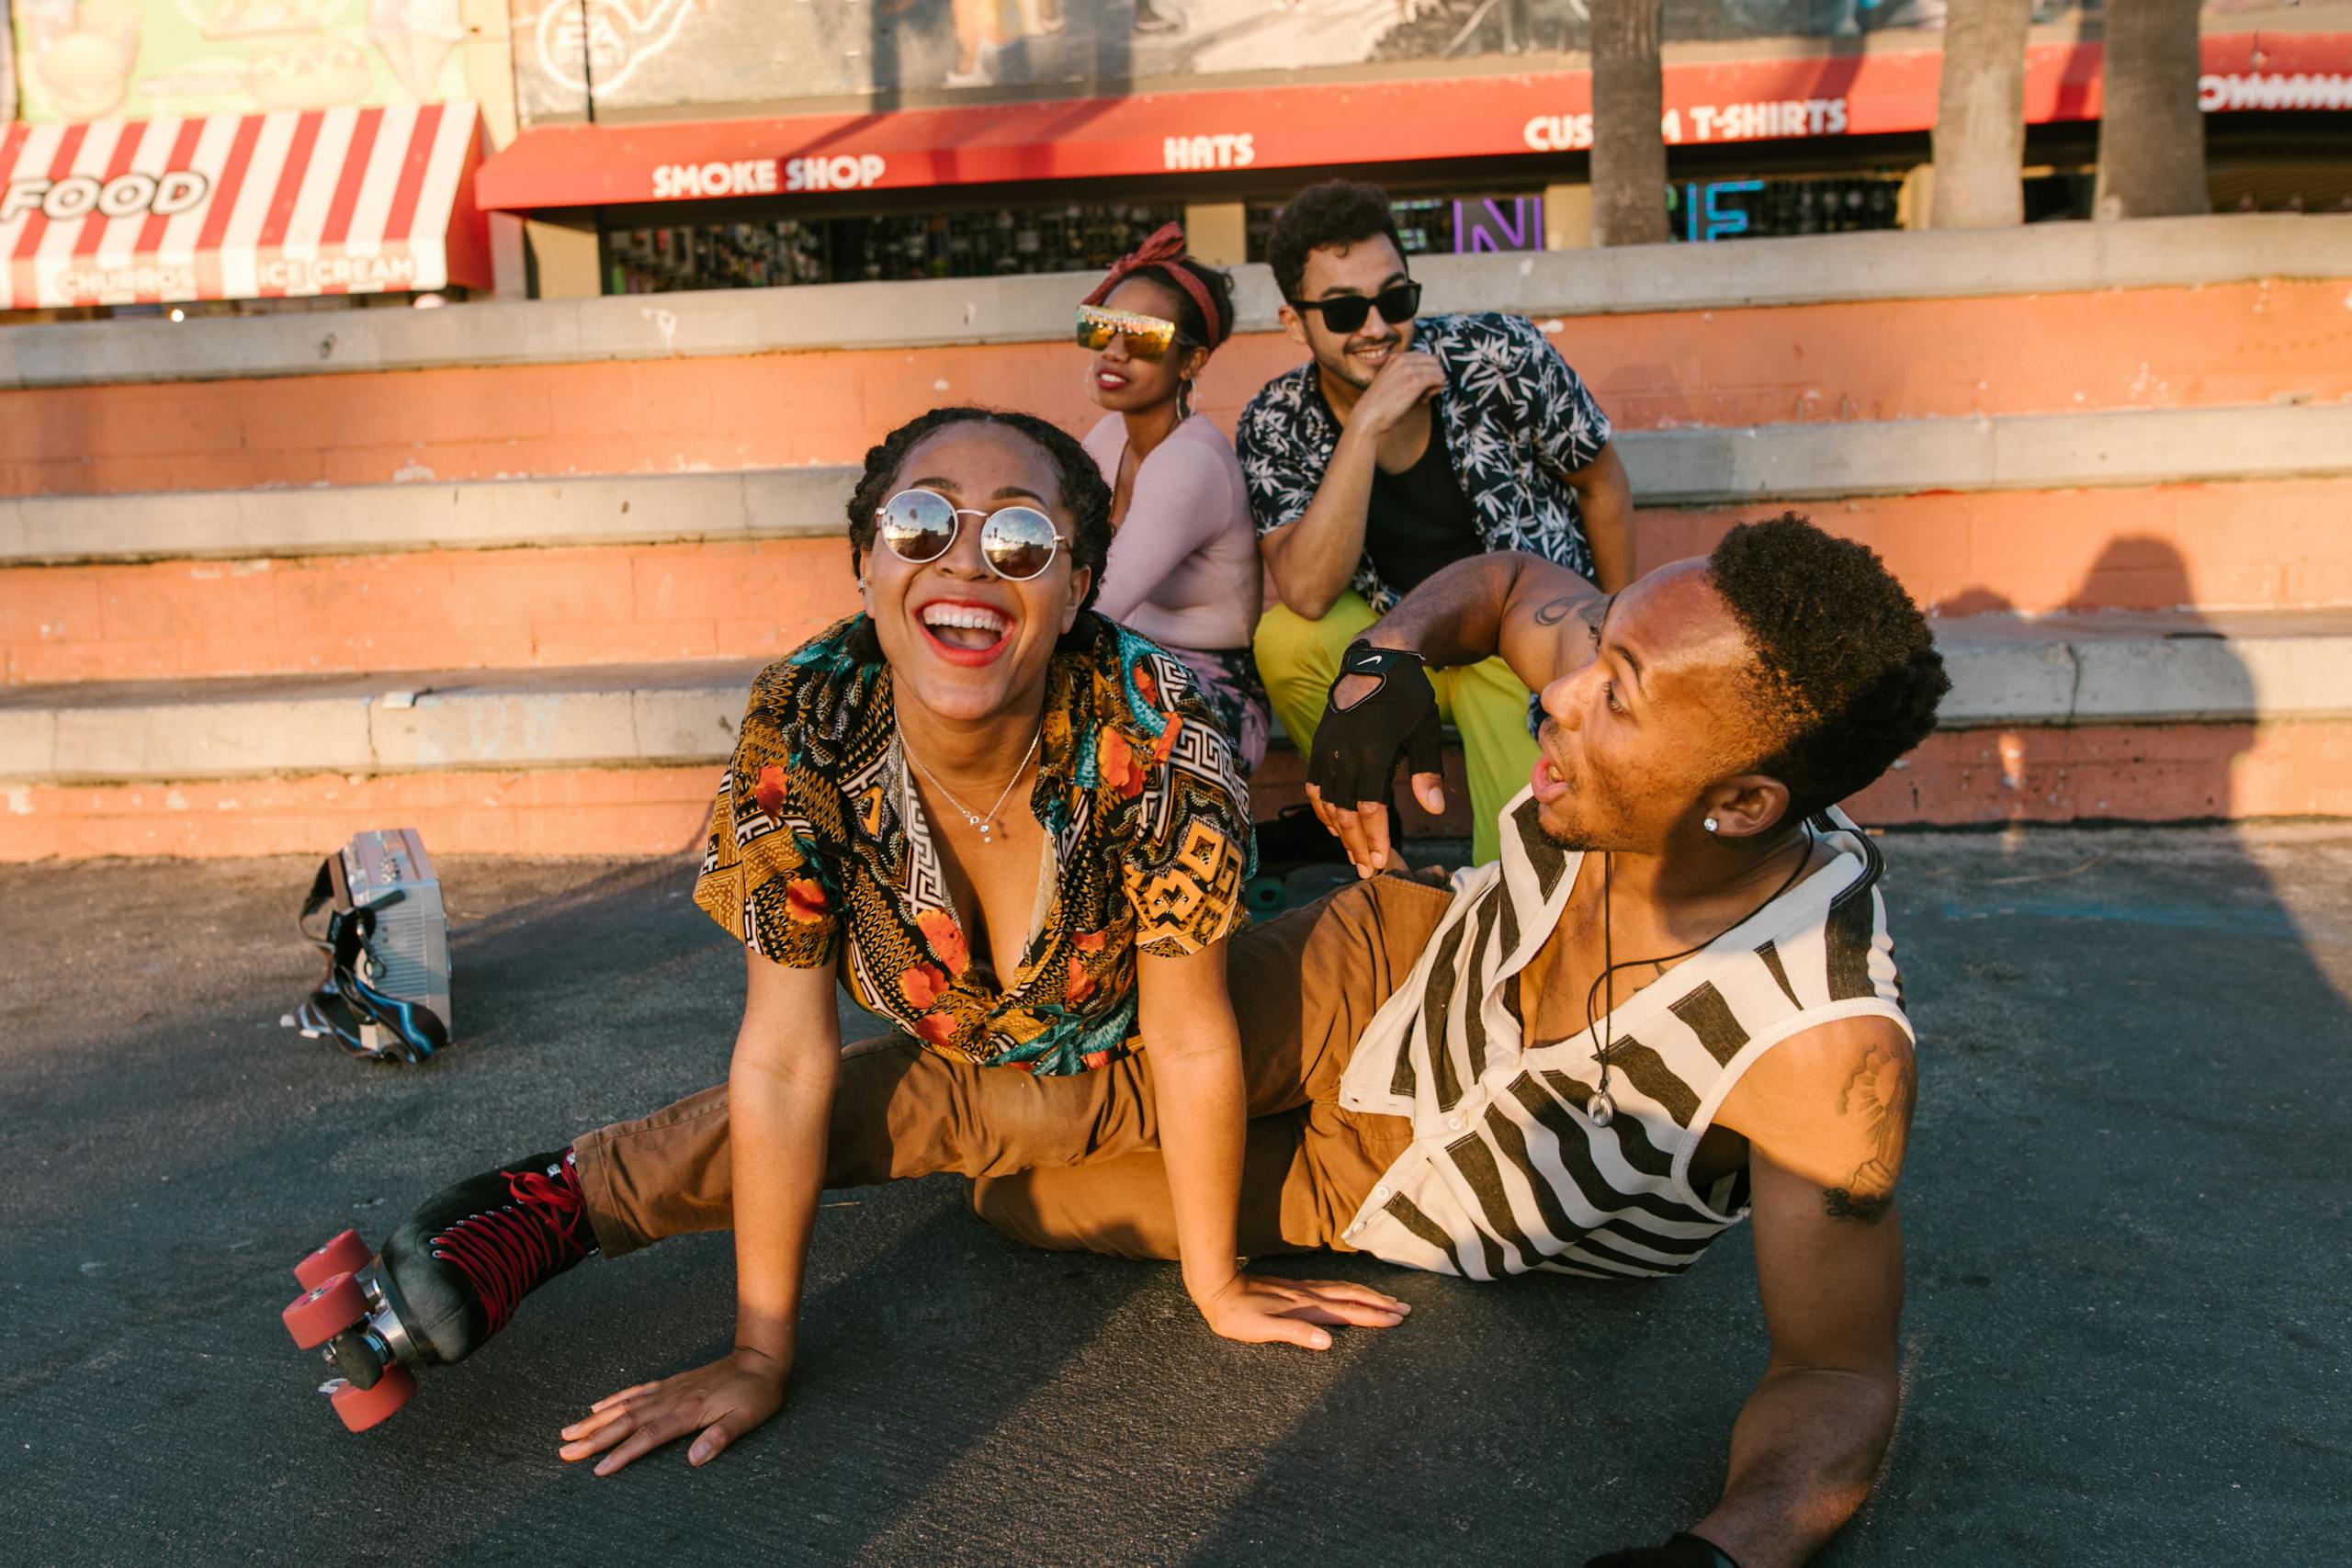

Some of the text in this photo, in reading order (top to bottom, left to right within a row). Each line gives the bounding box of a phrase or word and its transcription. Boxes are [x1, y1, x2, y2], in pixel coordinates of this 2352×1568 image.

[1690, 99, 1847, 142] T-SHIRTS
[1162, 132, 1255, 170] HATS
[652, 153, 886, 198] SMOKE SHOP
[0, 171, 209, 223] FOOD
[60, 265, 195, 295] CHURROS
[258, 257, 413, 288] ICE CREAM
